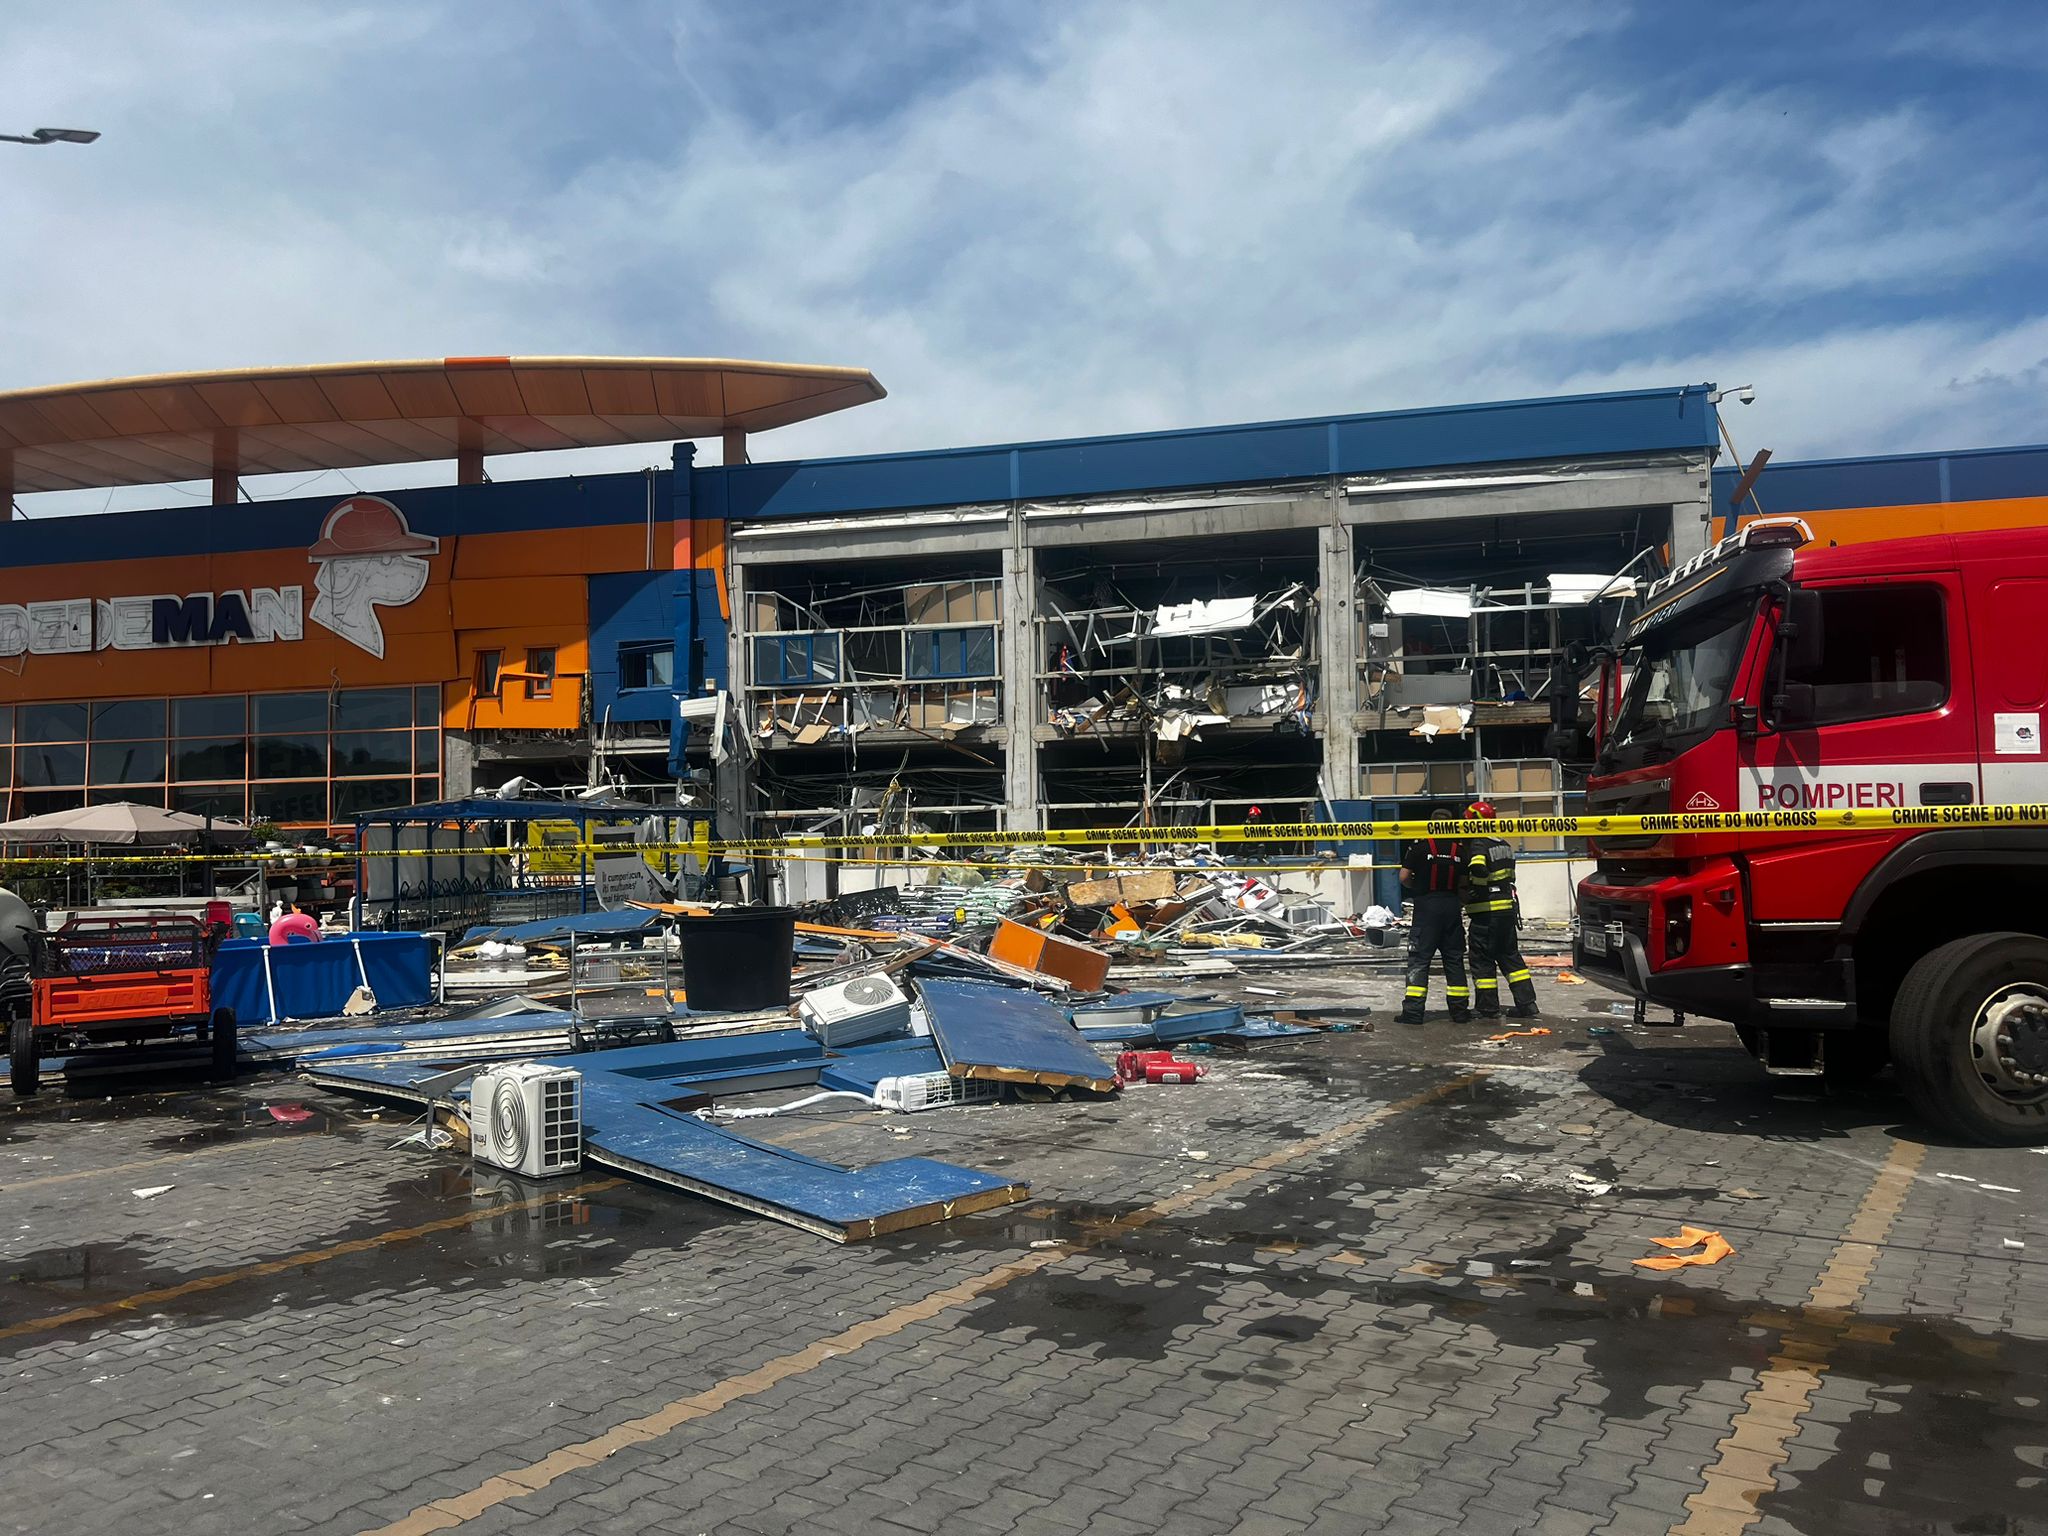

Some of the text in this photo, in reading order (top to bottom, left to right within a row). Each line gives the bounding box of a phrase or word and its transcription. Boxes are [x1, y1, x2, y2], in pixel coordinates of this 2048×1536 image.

[1758, 783, 1904, 809] POMPIERI
[1641, 812, 1817, 830] CRIME SCENE DO NOT CROSS
[1893, 805, 2048, 824] CRIME SCENE DO NOT
[1244, 824, 1373, 838] CRIME SCENE DO NOT CROSS
[1428, 822, 1460, 834] CRIME
[1463, 820, 1496, 834] SCENE
[1500, 820, 1513, 832] DO
[1517, 819, 1538, 832] NOT
[1542, 818, 1577, 831] CROSS
[842, 837, 864, 845] SCENE
[875, 836, 888, 844] NOT
[889, 836, 912, 844] CROSS
[946, 832, 1046, 843] CRIME SCENE DO NOT CROSS
[1086, 828, 1198, 840] CRIME SCENE DO NOT CROSS
